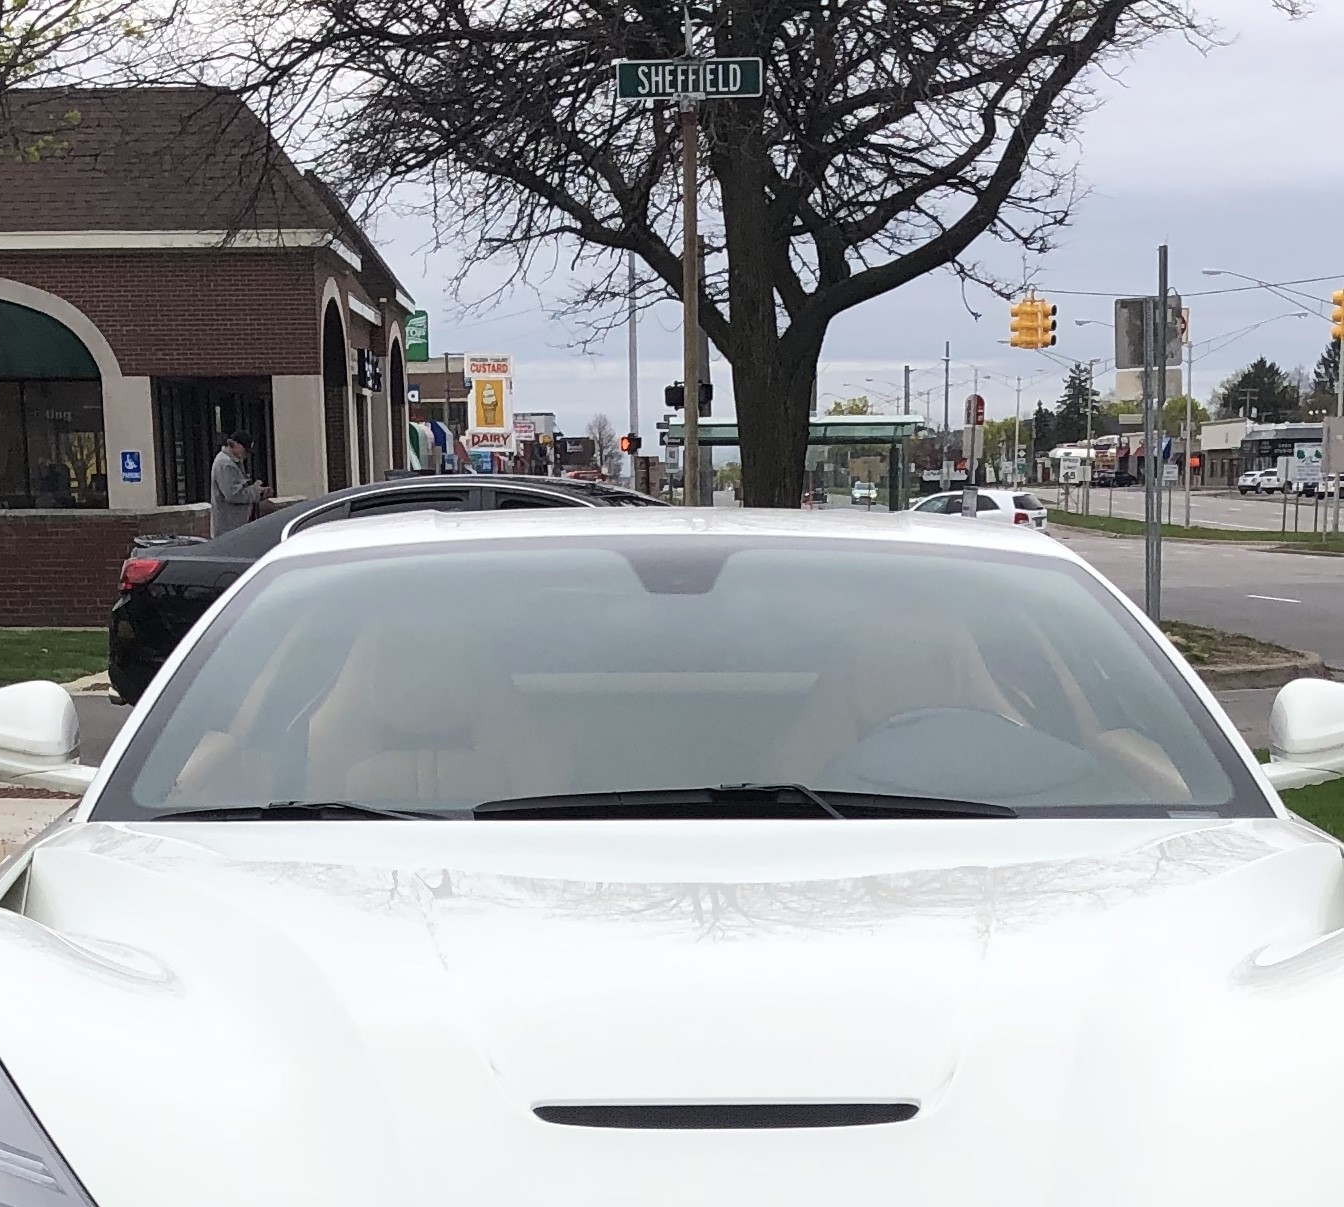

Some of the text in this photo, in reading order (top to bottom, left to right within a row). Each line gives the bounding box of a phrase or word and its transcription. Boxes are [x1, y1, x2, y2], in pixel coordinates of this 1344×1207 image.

[637, 64, 741, 94] SHEFFIELD
[470, 363, 508, 373] CUSTARD
[471, 433, 511, 447] DAIRY
